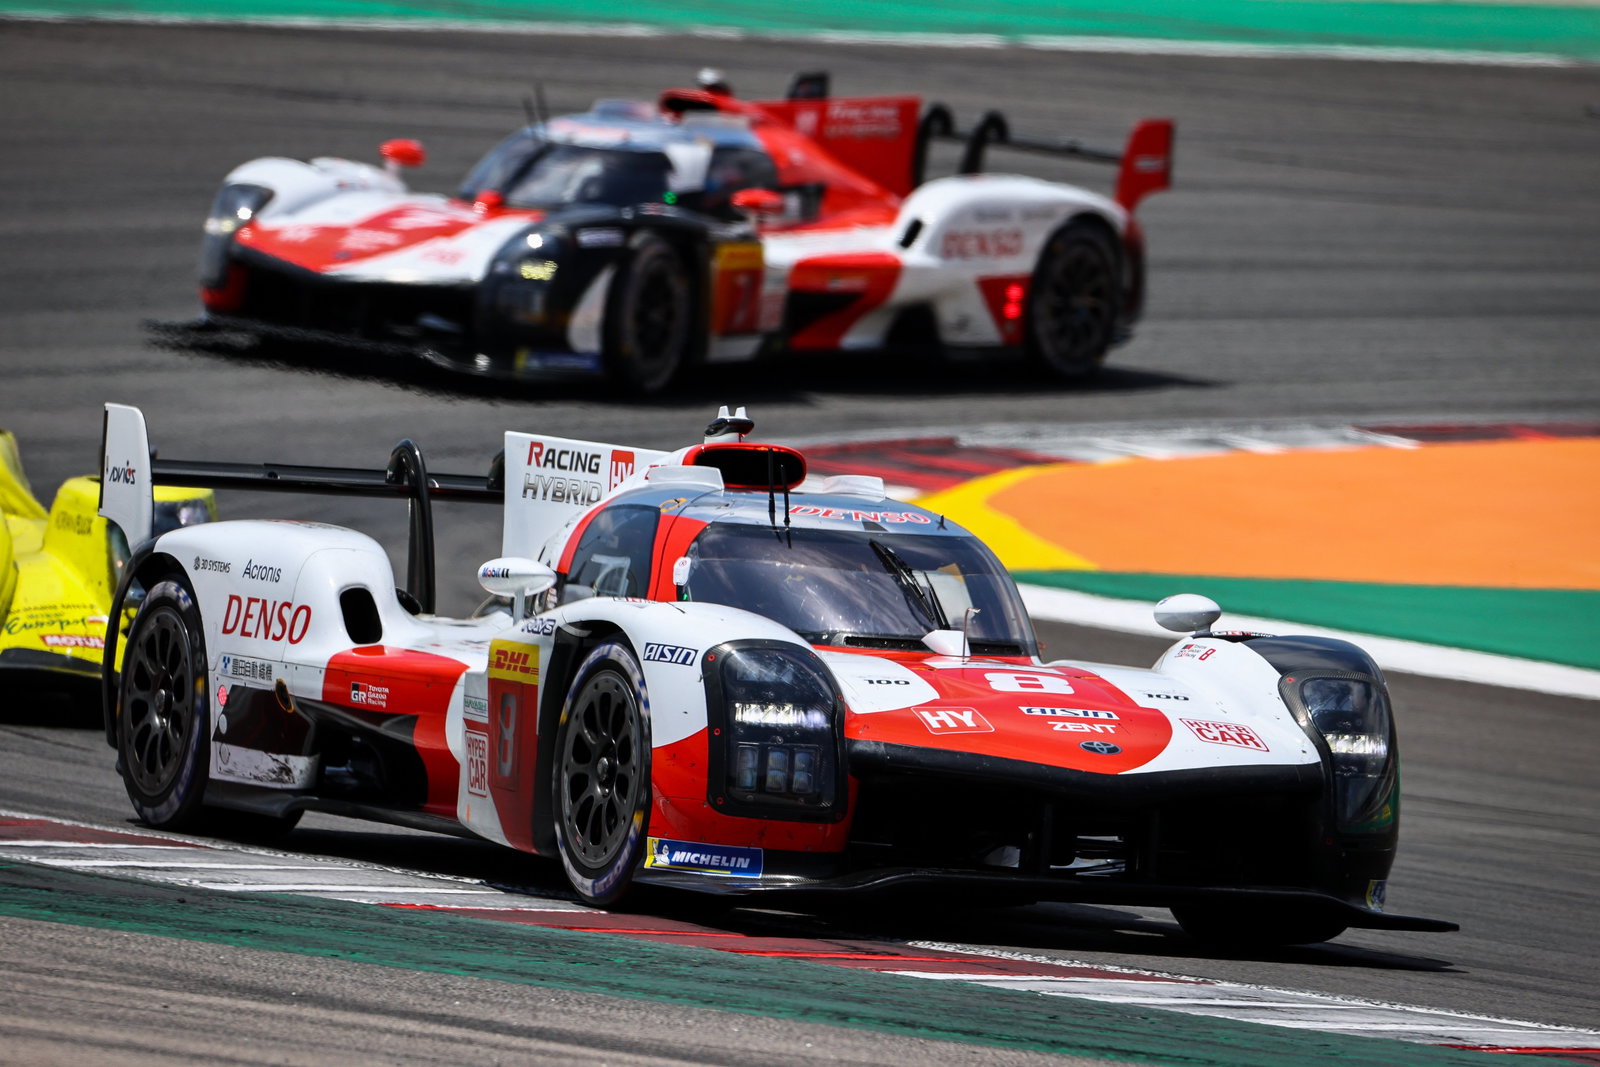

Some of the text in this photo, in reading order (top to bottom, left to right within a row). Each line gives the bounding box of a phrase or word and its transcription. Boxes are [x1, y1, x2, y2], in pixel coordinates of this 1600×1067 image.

[527, 441, 602, 474] RACING
[522, 472, 603, 507] HYBRID
[789, 504, 931, 524] DENSO
[208, 560, 231, 574] SYSTEMS
[242, 558, 282, 583] Acronis
[482, 567, 500, 578] Mobil
[222, 594, 312, 645] DENSO
[494, 649, 531, 674] DHL
[644, 644, 697, 665] AISIN
[983, 672, 1075, 695] 8
[351, 690, 367, 704] GR
[919, 710, 977, 729] HY
[1025, 707, 1114, 719] AISIN
[498, 692, 517, 777] 8
[1047, 721, 1117, 734] ZENT
[1186, 720, 1250, 735] HYPER
[1196, 727, 1262, 748] CAR
[466, 735, 487, 760] HYPER
[468, 756, 487, 792] CAR
[671, 850, 751, 869] MICHELIN
